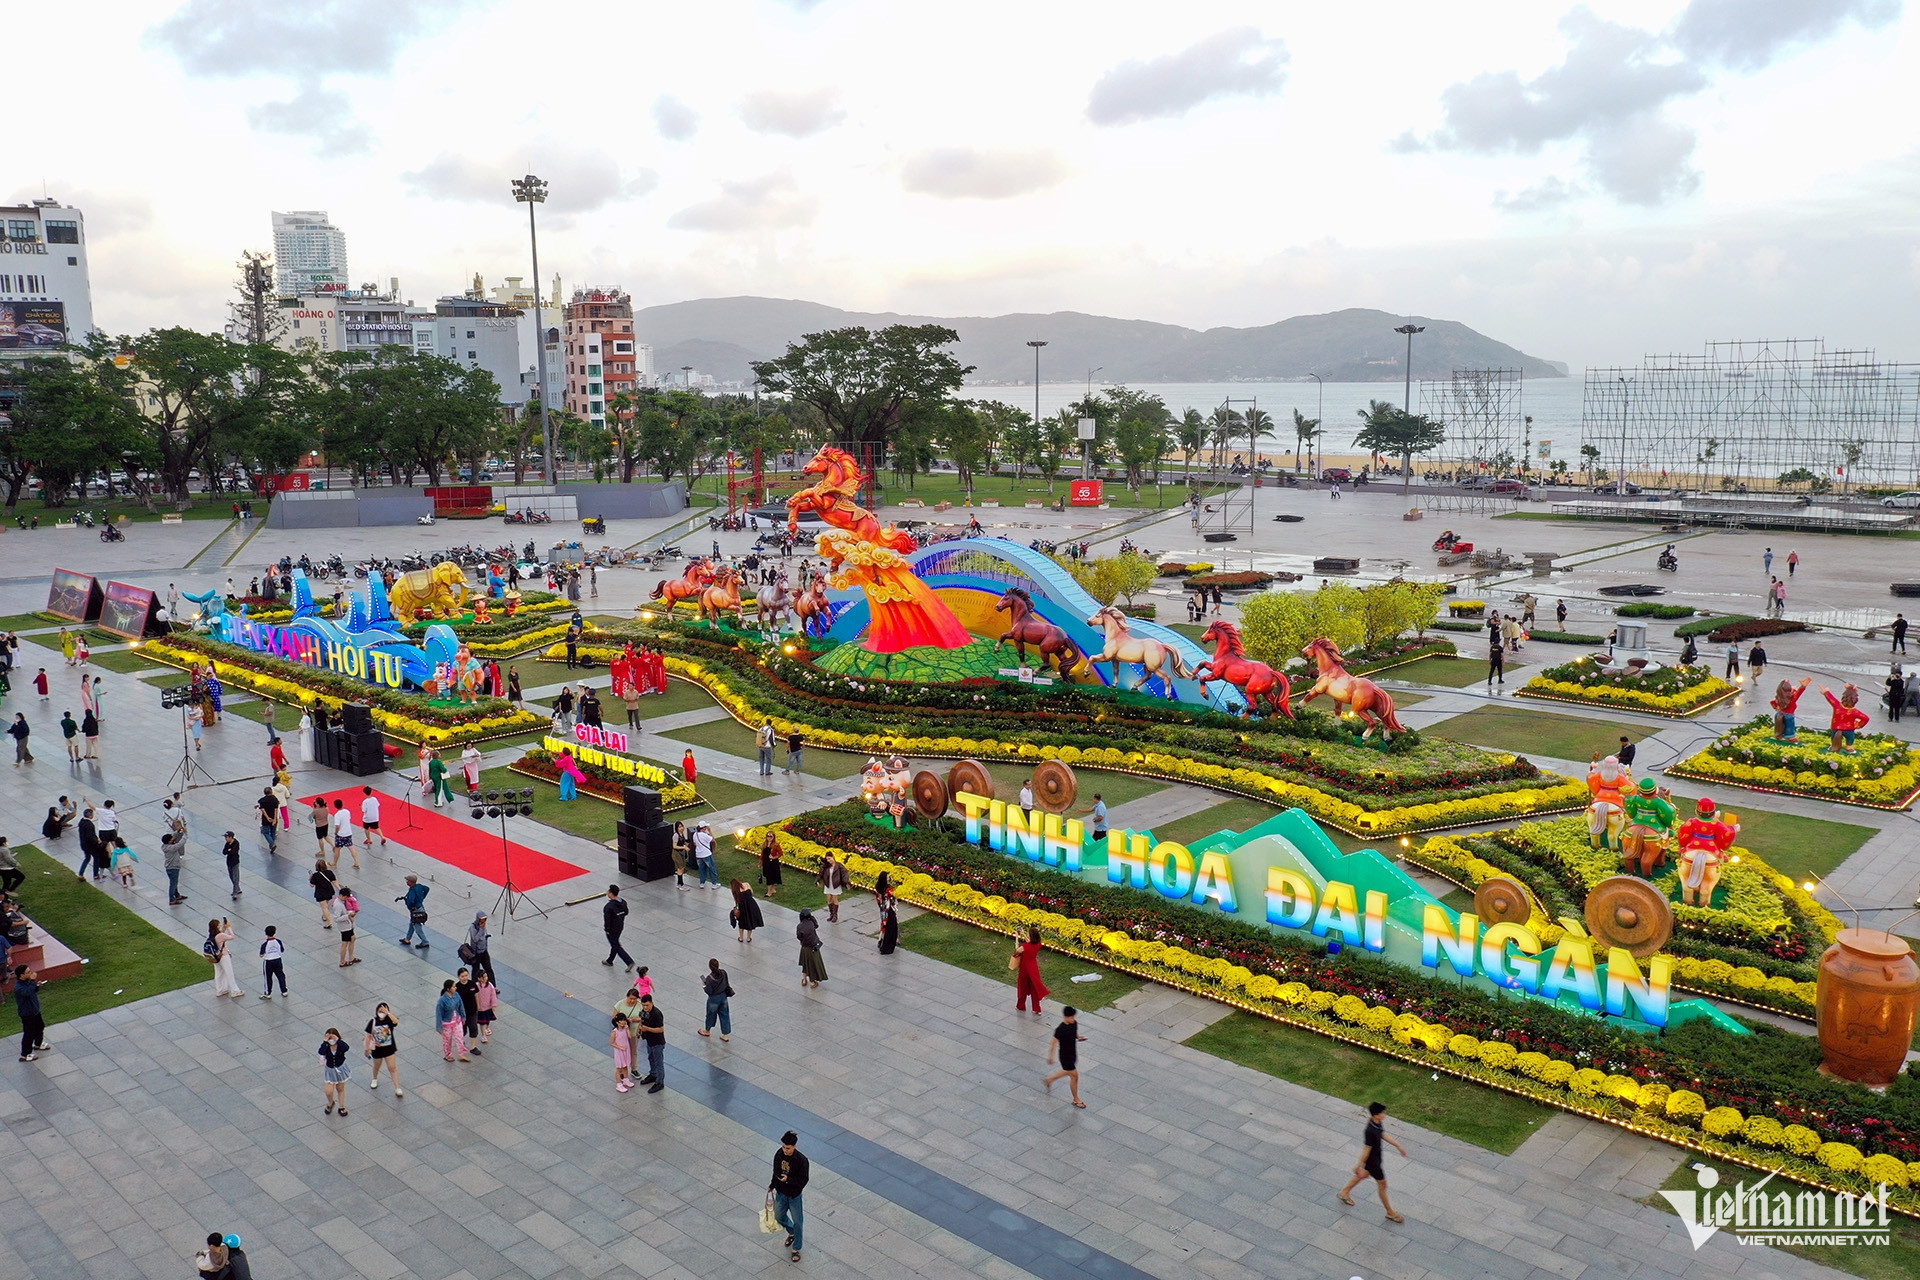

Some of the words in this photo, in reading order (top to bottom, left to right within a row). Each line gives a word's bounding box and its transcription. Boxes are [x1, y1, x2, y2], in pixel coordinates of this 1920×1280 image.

[15, 243, 49, 255] HOTEL
[292, 308, 324, 318] HOÀNG
[361, 323, 387, 331] STATION
[320, 321, 329, 352] HOTE
[1078, 489, 1091, 497] 5G
[265, 624, 323, 667] XANH
[575, 722, 603, 746] GIA
[604, 729, 628, 753] LAI
[580, 746, 604, 766] NEW
[605, 752, 635, 776] YEAR
[636, 761, 665, 784] 2026
[956, 791, 1084, 872] TINH
[1107, 828, 1239, 914] HOA
[1421, 904, 1672, 1027] NGÀN
